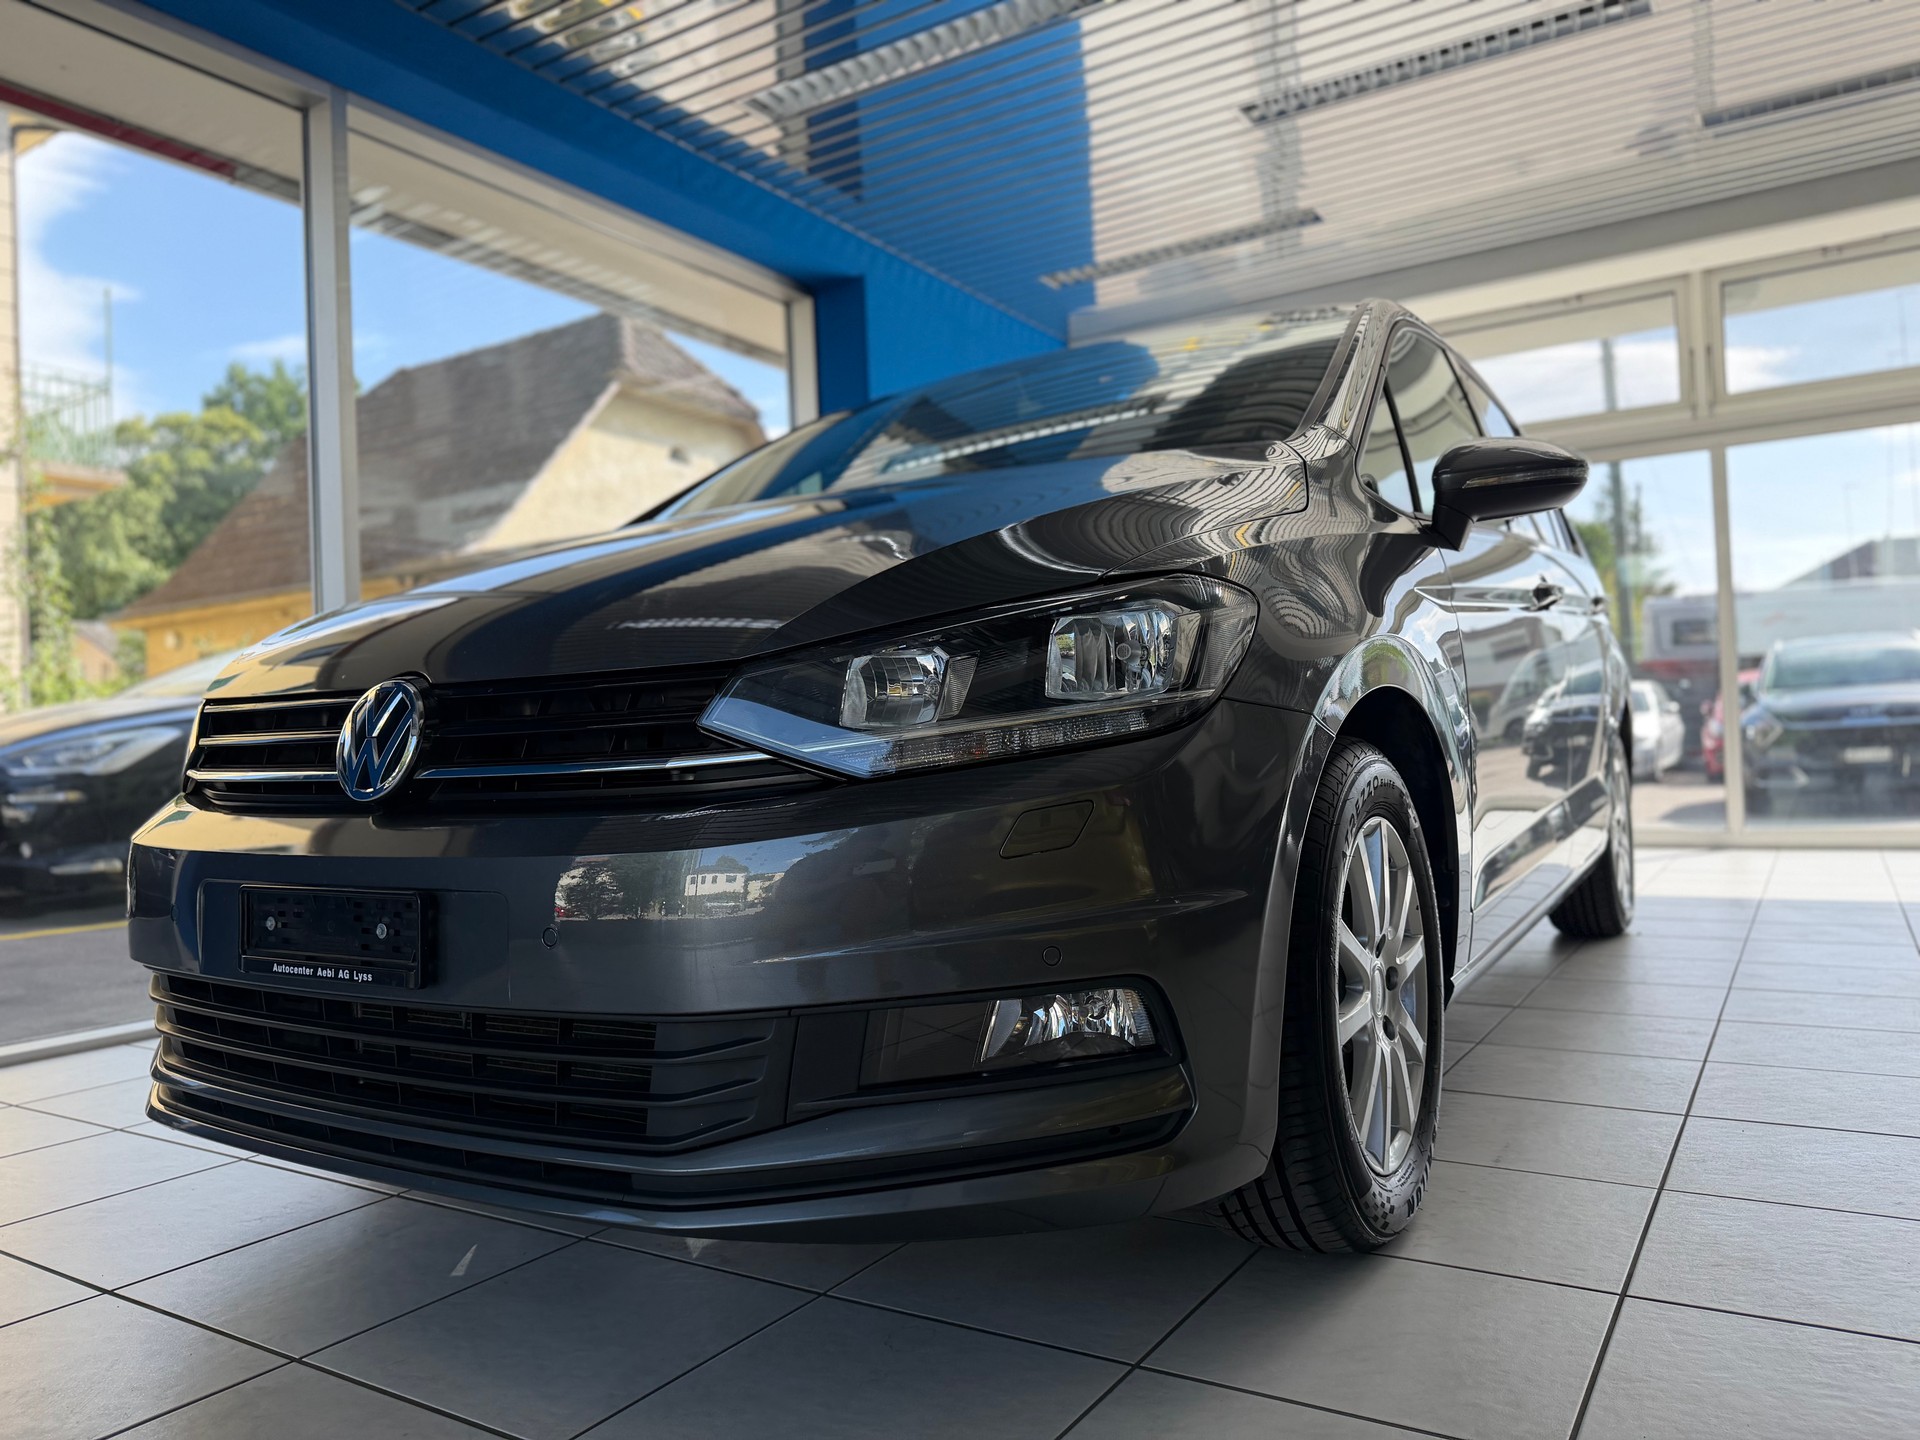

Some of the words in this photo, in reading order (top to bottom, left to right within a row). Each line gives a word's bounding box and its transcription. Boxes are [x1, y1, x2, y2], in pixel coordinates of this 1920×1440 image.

[1380, 778, 1396, 790] ELITE
[272, 962, 314, 976] Autocenter
[317, 967, 335, 978] Aebi
[338, 969, 350, 979] AG
[353, 970, 373, 983] Lyss
